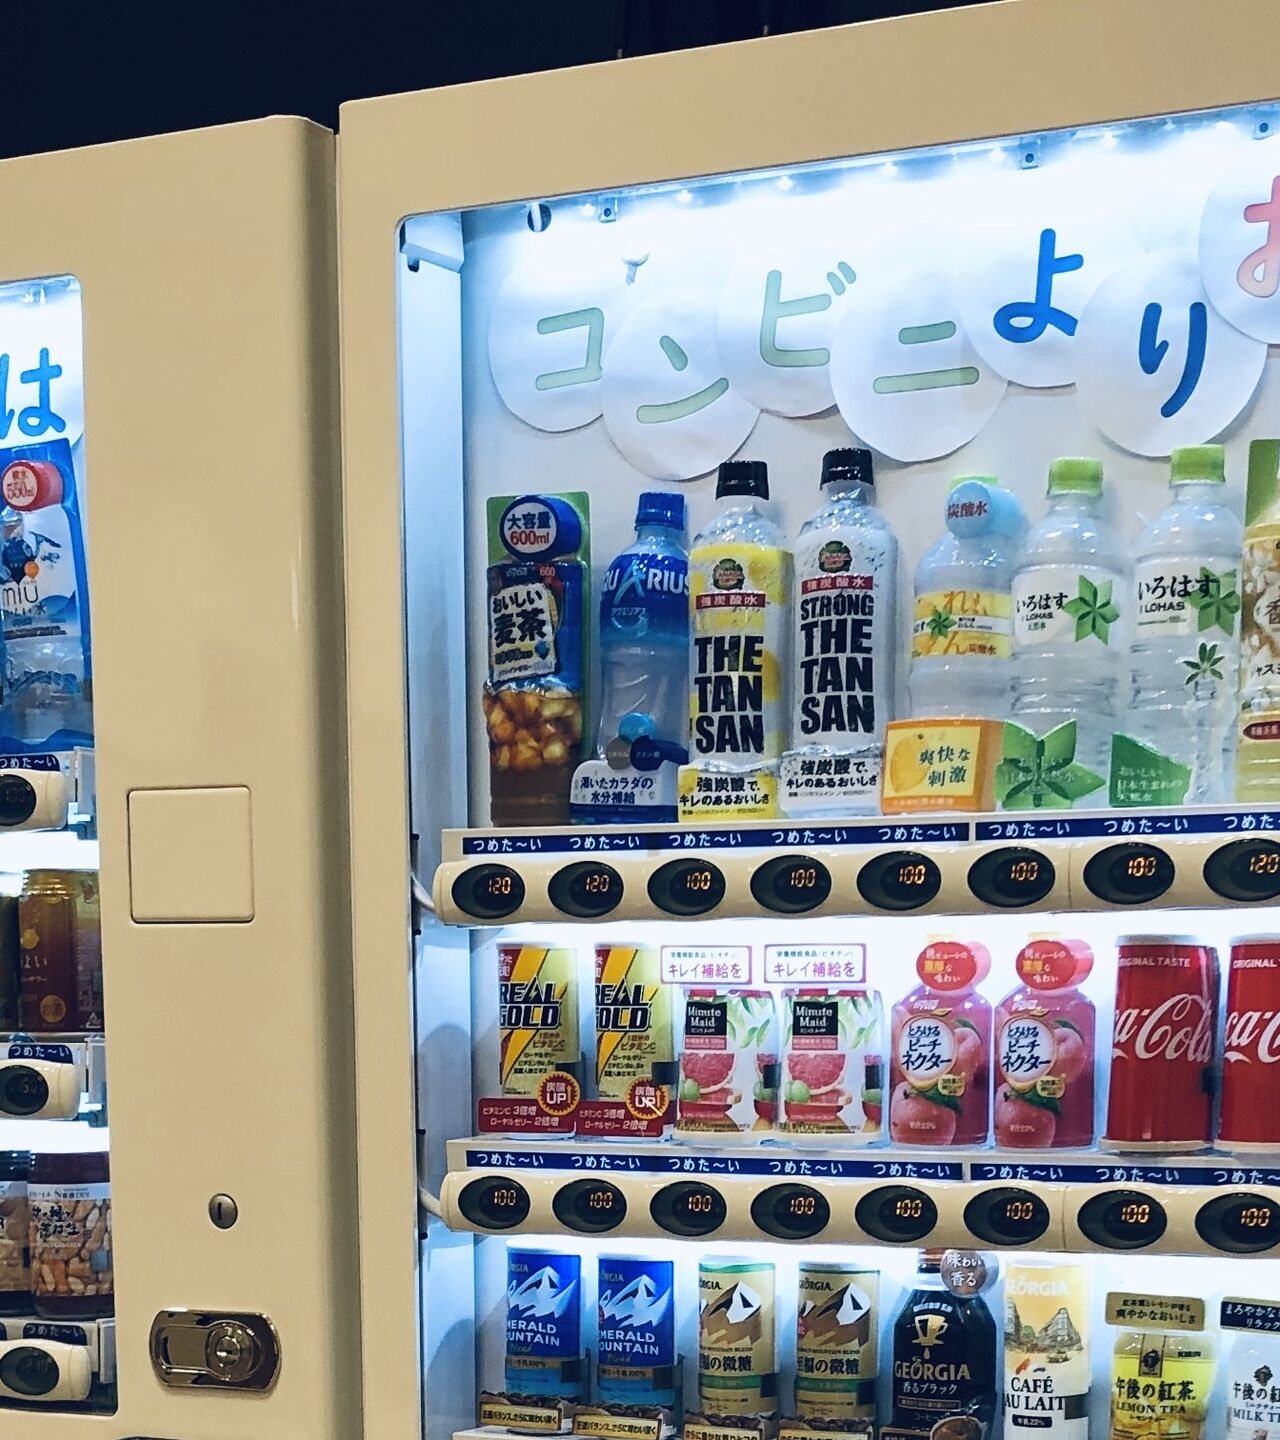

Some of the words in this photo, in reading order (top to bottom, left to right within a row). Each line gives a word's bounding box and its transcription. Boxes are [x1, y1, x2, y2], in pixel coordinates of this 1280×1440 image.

[947, 500, 989, 519] 炭酸水
[507, 512, 552, 531] 大容量
[510, 530, 550, 546] 600ml
[806, 578, 868, 592] 強炭酸水
[1138, 577, 1220, 600] いろはす
[493, 591, 543, 613] おいしい
[800, 593, 874, 621] STRONG
[1016, 592, 1068, 614] いろはす
[494, 615, 547, 649] 麦茶
[801, 619, 873, 657] THE
[694, 635, 764, 672] THE
[800, 657, 874, 695] TAN
[694, 677, 764, 713] TAN
[800, 695, 875, 735] SAN
[695, 715, 765, 754] SAN
[919, 746, 971, 764] 爽快な
[928, 766, 967, 788] 刺激
[988, 822, 1070, 838] つめた〜い
[569, 836, 639, 849] つめた〜い
[1010, 862, 1038, 881] 100
[1249, 854, 1279, 874] 120
[586, 875, 610, 892] 120
[773, 962, 855, 979] キレイ補給を
[1157, 957, 1190, 967] TASTE
[1233, 959, 1276, 968] ORIGINAL
[668, 963, 742, 980] キレイ補給を
[688, 1004, 722, 1018] Minute
[796, 1004, 833, 1018] Minute
[690, 1017, 716, 1029] Maid
[799, 1017, 827, 1028] Maid
[908, 1026, 941, 1038] とろける
[1008, 1025, 1039, 1038] とろける
[908, 1039, 941, 1052] ピーチ
[1008, 1039, 1040, 1052] ピーチ
[901, 1051, 953, 1072] ネクター
[1002, 1052, 1051, 1072] ネクター
[546, 1093, 567, 1104] UP
[635, 1096, 656, 1107] UP
[769, 1160, 843, 1175] つめた〜い
[589, 1191, 613, 1208] 100
[790, 1197, 815, 1215] 100
[1240, 1207, 1271, 1226] 100
[946, 1253, 982, 1269] 味わい
[950, 1272, 977, 1288] 香る
[1115, 1308, 1197, 1325] 爽やかなおいしさ
[599, 1330, 655, 1342] MERALD
[600, 1342, 659, 1355] OUNTAIN
[894, 1356, 970, 1381] GEORGIA
[903, 1381, 958, 1396] 香るブラック
[1011, 1376, 1054, 1394] CAFÉ
[1116, 1379, 1192, 1402] 午後の紅茶
[1005, 1395, 1028, 1411] AU
[1030, 1395, 1066, 1412] LAIT
[1116, 1402, 1156, 1414] LEMON
[1159, 1404, 1186, 1414] TEA
[1233, 1407, 1264, 1423] MILK
